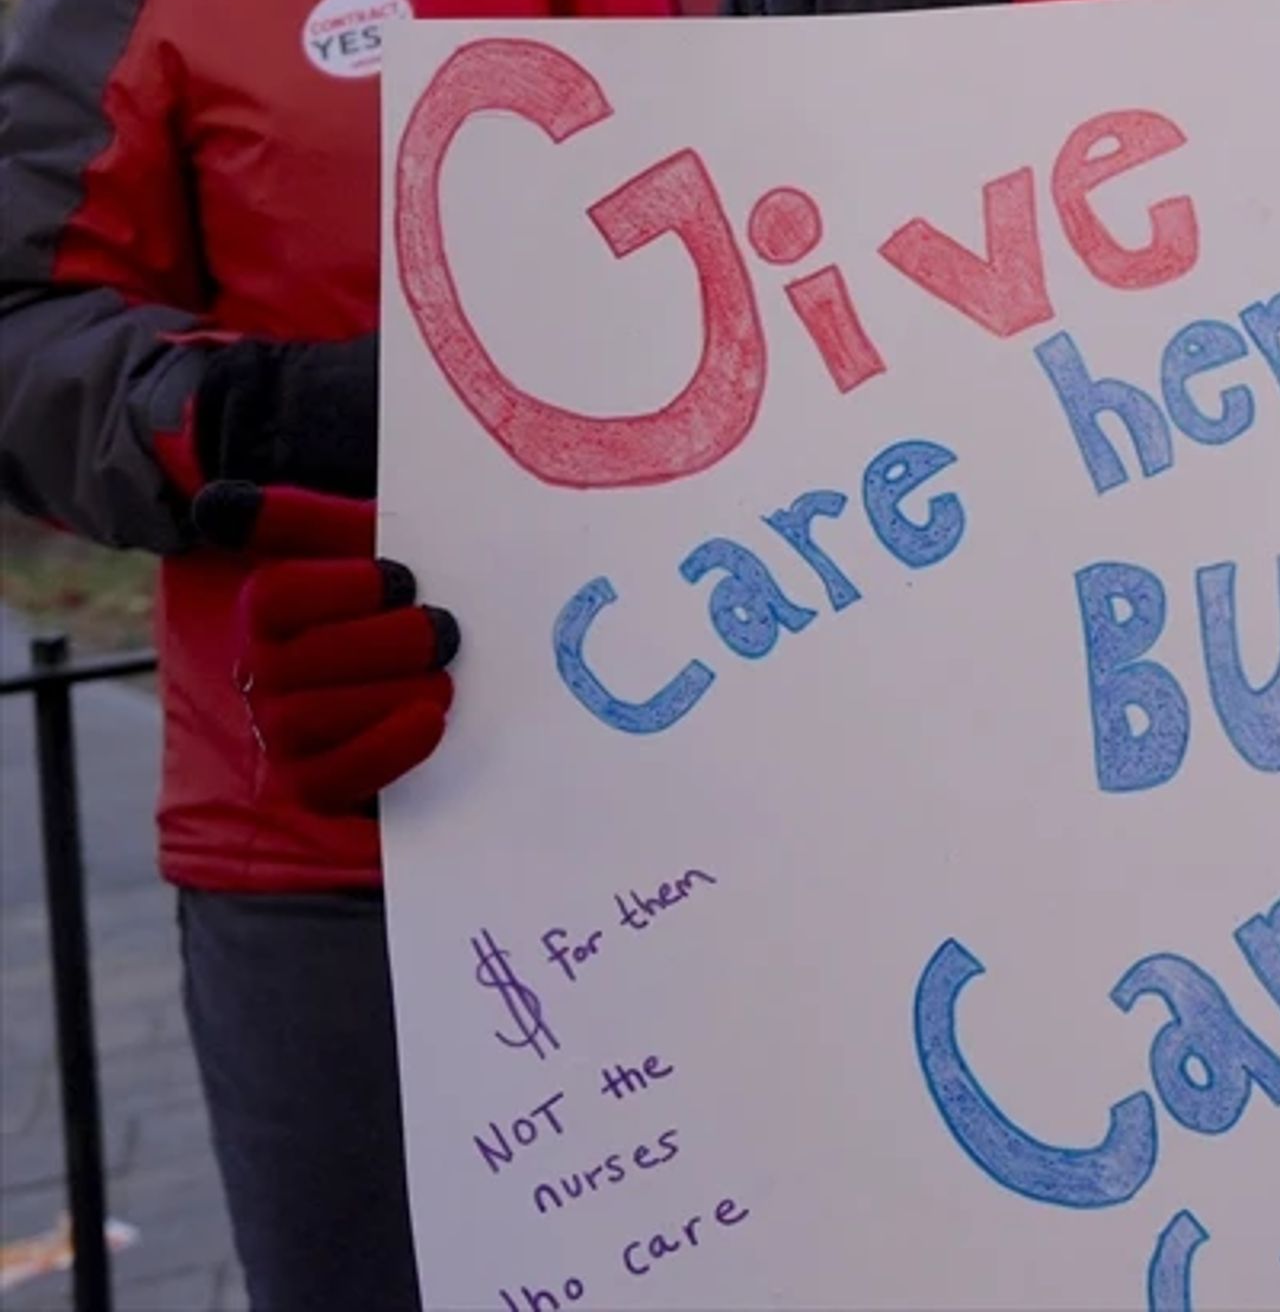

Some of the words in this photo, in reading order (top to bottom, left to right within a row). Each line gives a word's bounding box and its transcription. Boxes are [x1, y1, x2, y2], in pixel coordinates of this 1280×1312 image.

[311, 25, 382, 60] YES
[397, 37, 1199, 491] Give
[470, 928, 561, 1061] $
[540, 928, 603, 981] for
[613, 869, 718, 930] them
[473, 1091, 565, 1174] NOT
[600, 1054, 674, 1099] the
[532, 1129, 679, 1213] nurses
[622, 1197, 750, 1276] care
